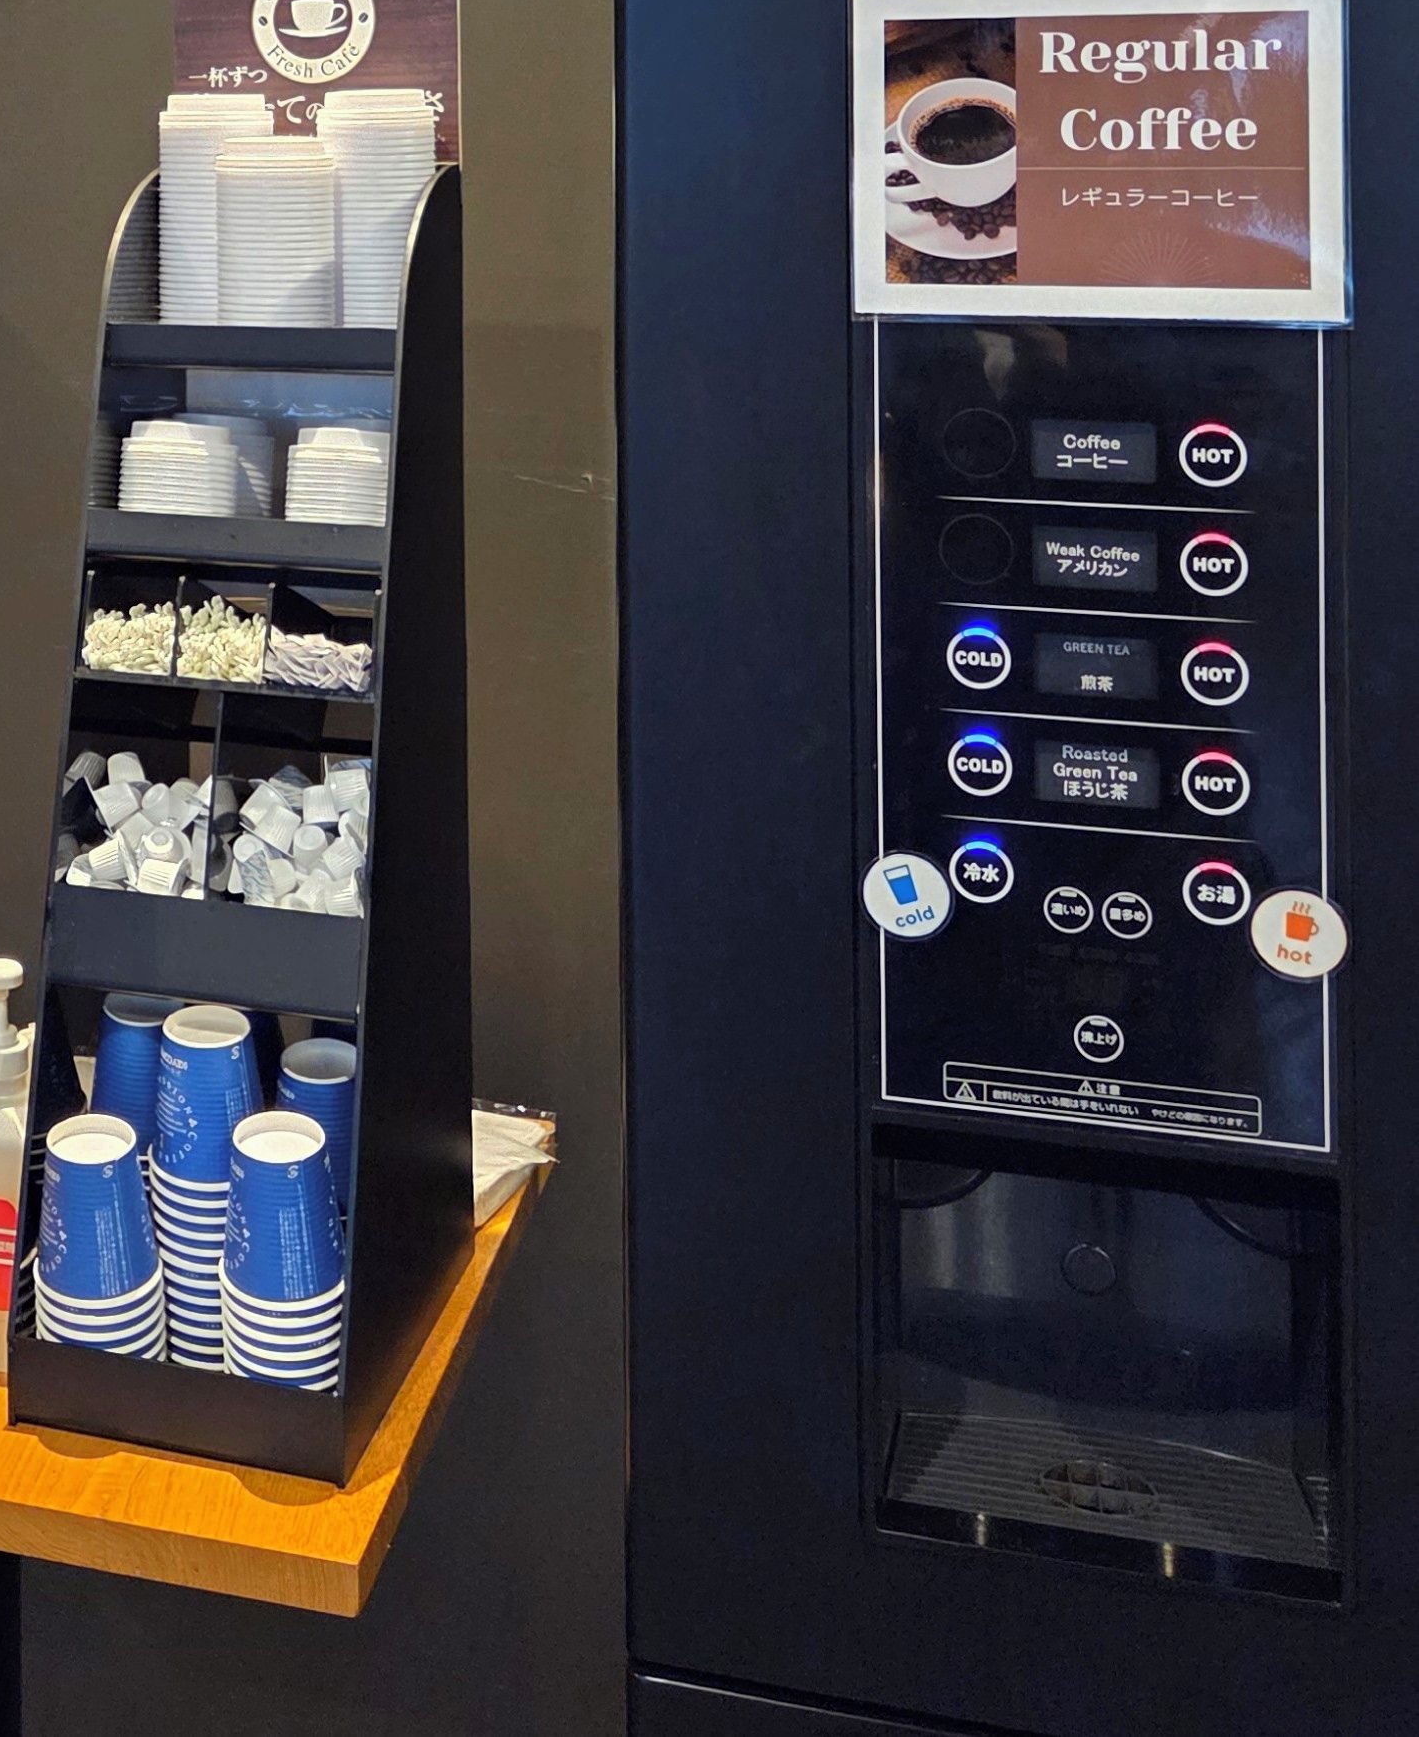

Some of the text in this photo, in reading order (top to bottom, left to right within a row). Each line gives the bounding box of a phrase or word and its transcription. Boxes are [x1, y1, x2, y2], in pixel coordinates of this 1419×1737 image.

[267, 45, 313, 79] Fresh
[1038, 28, 1283, 84] Regular
[189, 65, 268, 88] 一杯ずつ
[1060, 106, 1259, 152] Coffee
[1061, 187, 1259, 209] レギュラーコーヒー
[1063, 433, 1121, 451] Coffee
[1056, 453, 1129, 470] コーヒー
[1191, 447, 1234, 465] HOT
[1046, 541, 1141, 563] Weak Coffee
[1056, 559, 1129, 578] アメリカン
[1192, 557, 1235, 574] HOT
[955, 649, 1003, 666] COLD
[1063, 640, 1131, 657] GREEN TEA
[1080, 675, 1114, 693] 煎茶
[1193, 667, 1236, 683] HOT
[1061, 745, 1128, 763] Roasted
[956, 756, 1004, 773] COLD
[1053, 764, 1138, 783] Green Tea
[1062, 781, 1129, 801] ほうじ茶
[1194, 775, 1237, 793] HOT
[963, 863, 1000, 883] 冷水
[1196, 884, 1236, 905] お湯
[894, 904, 936, 929] cold
[1276, 943, 1312, 965] hot
